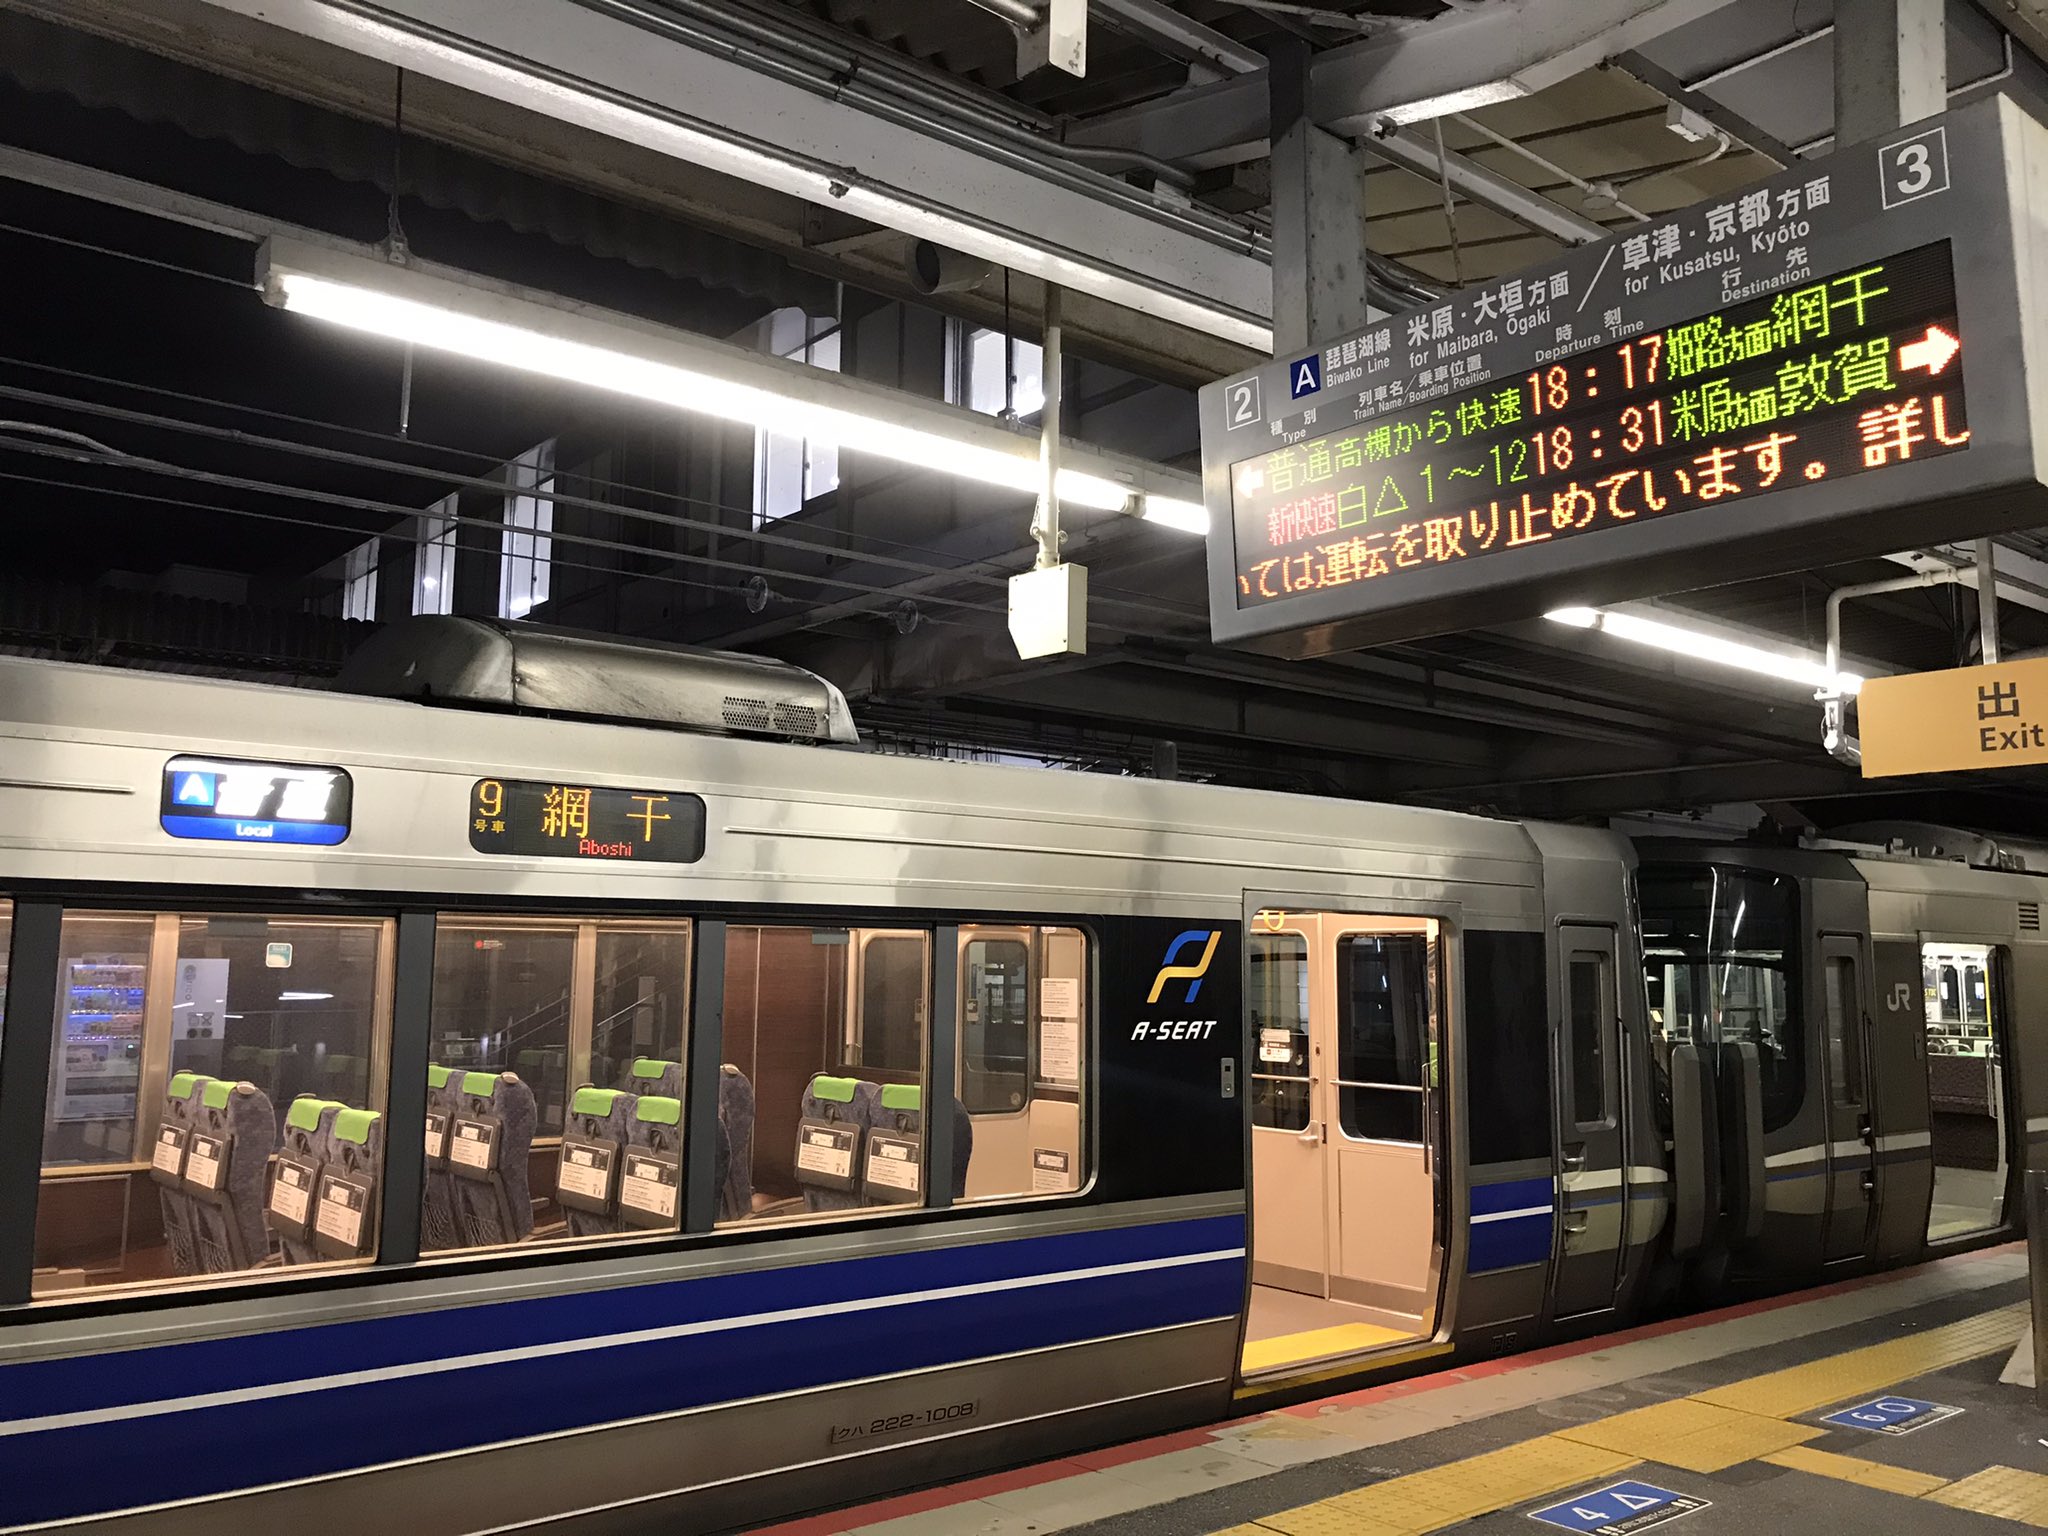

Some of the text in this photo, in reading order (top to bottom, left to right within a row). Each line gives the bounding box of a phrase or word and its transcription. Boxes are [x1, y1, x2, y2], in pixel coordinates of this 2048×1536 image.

[1895, 143, 1933, 195] 3
[1625, 220, 1810, 296] for Kusatsu, Kyōto
[1721, 264, 1811, 303] Destination
[1325, 328, 1392, 372] 琵琶湖線
[1409, 305, 1550, 369] for Maibara, Ōgaki
[1535, 319, 1645, 363] Departure Time
[1295, 362, 1316, 394] A
[1326, 356, 1391, 388] Biwako Line
[1233, 386, 1253, 423] 2
[1353, 406, 1375, 420] Train
[1453, 369, 1491, 389] Position
[1282, 428, 1306, 444] Type
[1978, 681, 2020, 721] 出
[1980, 722, 2045, 752] Exit
[179, 773, 209, 803] A
[478, 780, 503, 817] 9
[235, 822, 273, 838] Local
[474, 819, 506, 834] 号車
[579, 838, 633, 857] Aboshi
[1886, 982, 1912, 1012] JR
[1130, 1020, 1218, 1041] A-SEAT
[870, 1401, 974, 1434] 222-1008
